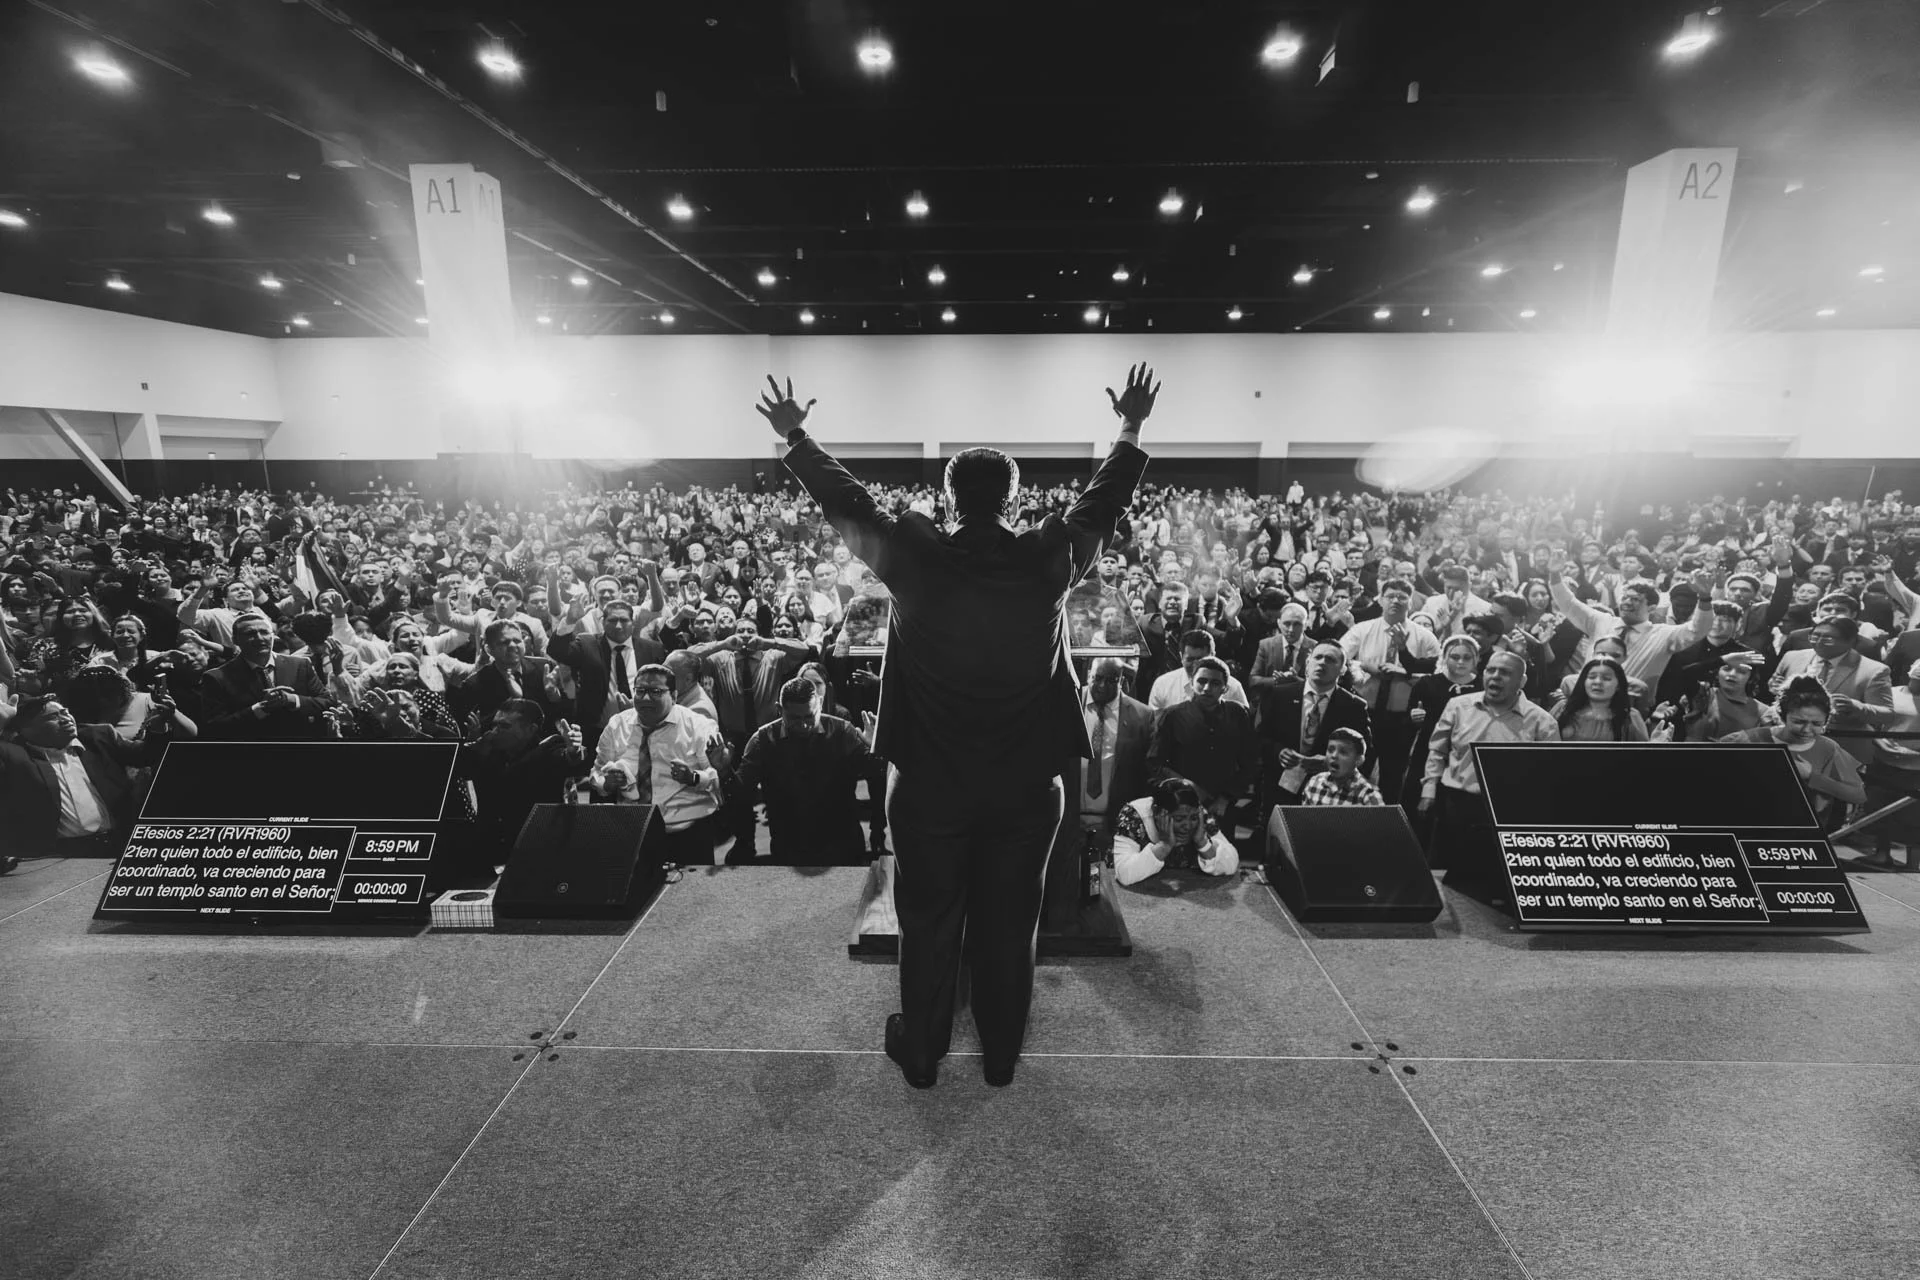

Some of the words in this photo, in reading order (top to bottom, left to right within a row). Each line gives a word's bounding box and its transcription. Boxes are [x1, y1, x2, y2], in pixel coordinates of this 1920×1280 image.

[1679, 162, 1722, 200] A2
[427, 177, 461, 214] A1
[133, 826, 184, 840] Efesios
[186, 827, 216, 840] 2:21
[217, 827, 291, 843] (RVR1960)
[1501, 833, 1556, 848] Efesios
[1558, 834, 1589, 848] 2:21
[1591, 834, 1670, 851] (RVR1960)
[124, 845, 157, 858] 21en
[160, 845, 199, 862] quien
[202, 845, 233, 859] todo
[236, 845, 251, 859] el
[252, 845, 303, 862] edificio,
[308, 846, 338, 860] bien
[365, 839, 395, 853] 8:59
[395, 839, 420, 853] PM
[1757, 847, 1790, 861] 8:59
[1790, 847, 1818, 861] PM
[1506, 852, 1541, 867] 21en
[1543, 853, 1586, 870] quien
[1587, 853, 1622, 867] todo
[1625, 853, 1639, 868] el
[1642, 853, 1700, 870] edificio,
[1700, 854, 1735, 868] bien
[117, 864, 197, 880] coordinado,
[203, 867, 220, 878] va
[222, 864, 290, 879] creciendo
[292, 867, 326, 882] para
[1512, 872, 1600, 889] coordinado,
[1601, 875, 1623, 887] va
[1625, 873, 1698, 888] creciendo
[1700, 876, 1737, 891] para
[109, 885, 134, 897] ser
[135, 886, 154, 897] un
[157, 883, 205, 901] templo
[207, 885, 247, 898] santo
[250, 886, 269, 898] en
[271, 884, 287, 898] el
[288, 884, 336, 901] Señor;
[354, 882, 407, 895] 00:00:00
[1777, 891, 1835, 904] 00:00:00
[1517, 895, 1541, 907] ser
[1545, 895, 1566, 907] un
[1567, 893, 1620, 911] templo
[1623, 894, 1666, 908] santo
[1669, 896, 1690, 908] en
[1692, 893, 1707, 908] el
[1708, 893, 1762, 910] Señor;
